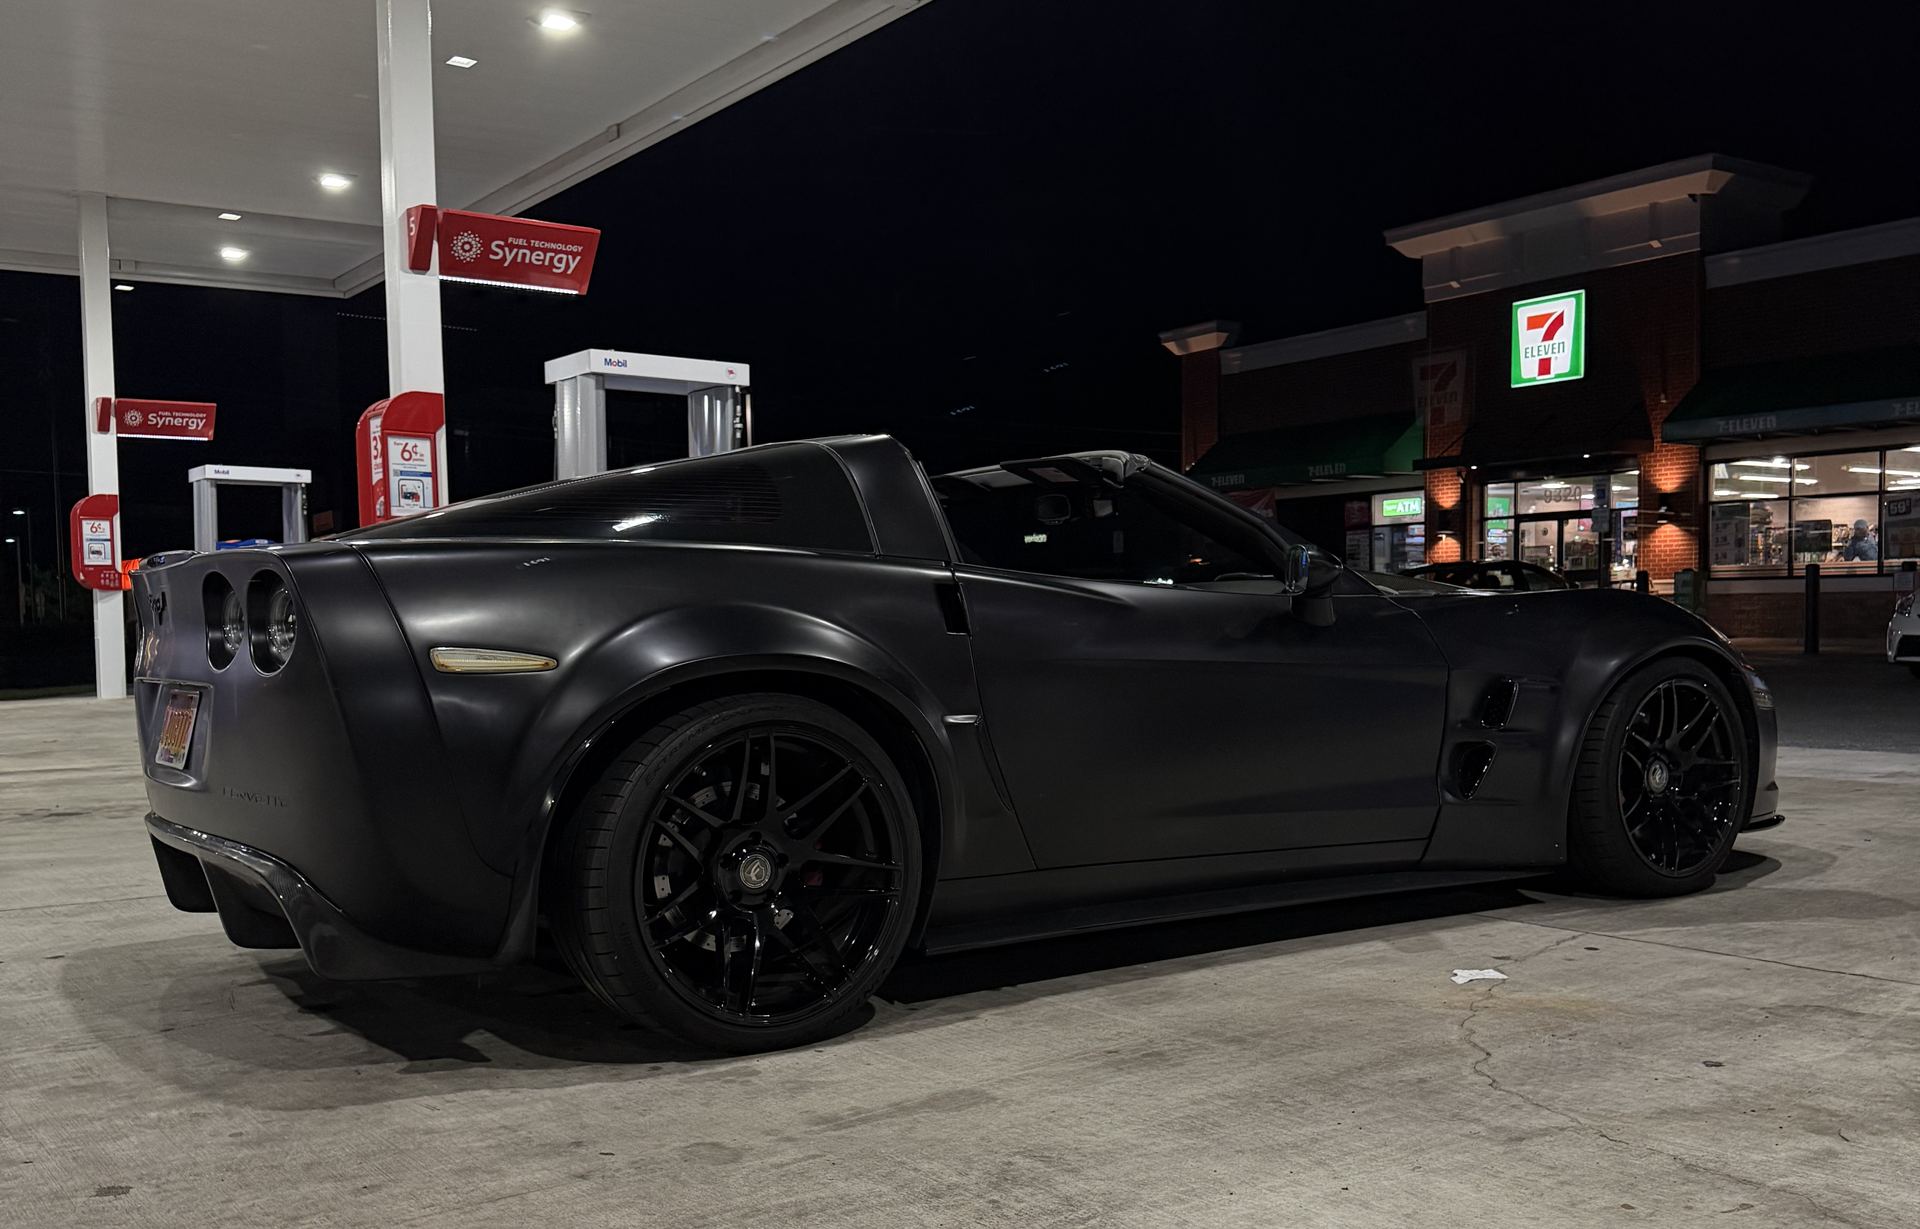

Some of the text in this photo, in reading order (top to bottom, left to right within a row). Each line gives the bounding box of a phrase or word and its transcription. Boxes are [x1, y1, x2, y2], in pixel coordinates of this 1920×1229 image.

[410, 217, 416, 235] 5
[508, 237, 584, 255] FUEL TECHNOLOGY
[489, 240, 581, 274] Synergy
[1524, 341, 1566, 358] ELEVEN
[1526, 310, 1565, 377] 7
[604, 358, 628, 368] Mobil
[147, 413, 206, 430] Synergy
[1543, 486, 1581, 504] 9320
[1396, 500, 1420, 513] ATM
